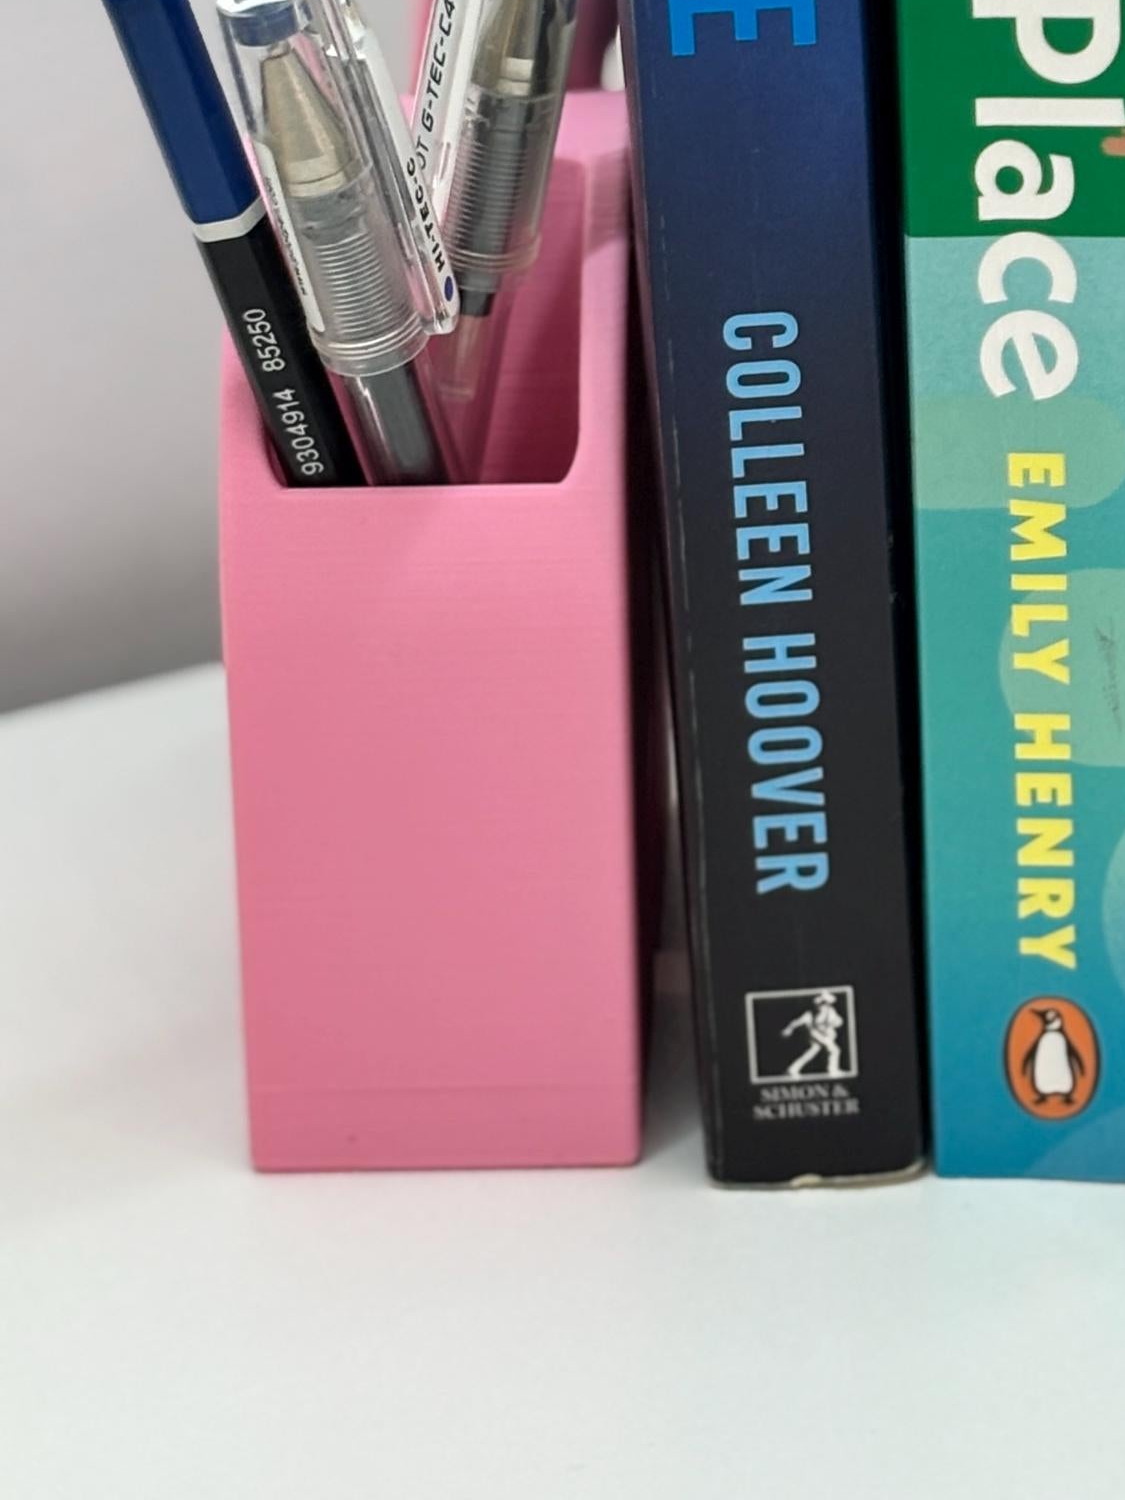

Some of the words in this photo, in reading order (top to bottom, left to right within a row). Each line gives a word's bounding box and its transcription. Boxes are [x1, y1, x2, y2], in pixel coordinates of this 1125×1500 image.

[242, 307, 286, 373] 85250
[273, 387, 325, 477] 9304914
[722, 311, 813, 606] COLLEEN
[1007, 452, 1070, 685] EMILY
[743, 633, 830, 895] HOOVER
[1014, 713, 1078, 971] HENRY
[753, 1099, 860, 1119] SCHUSTER
[760, 1085, 829, 1102] SIMON
